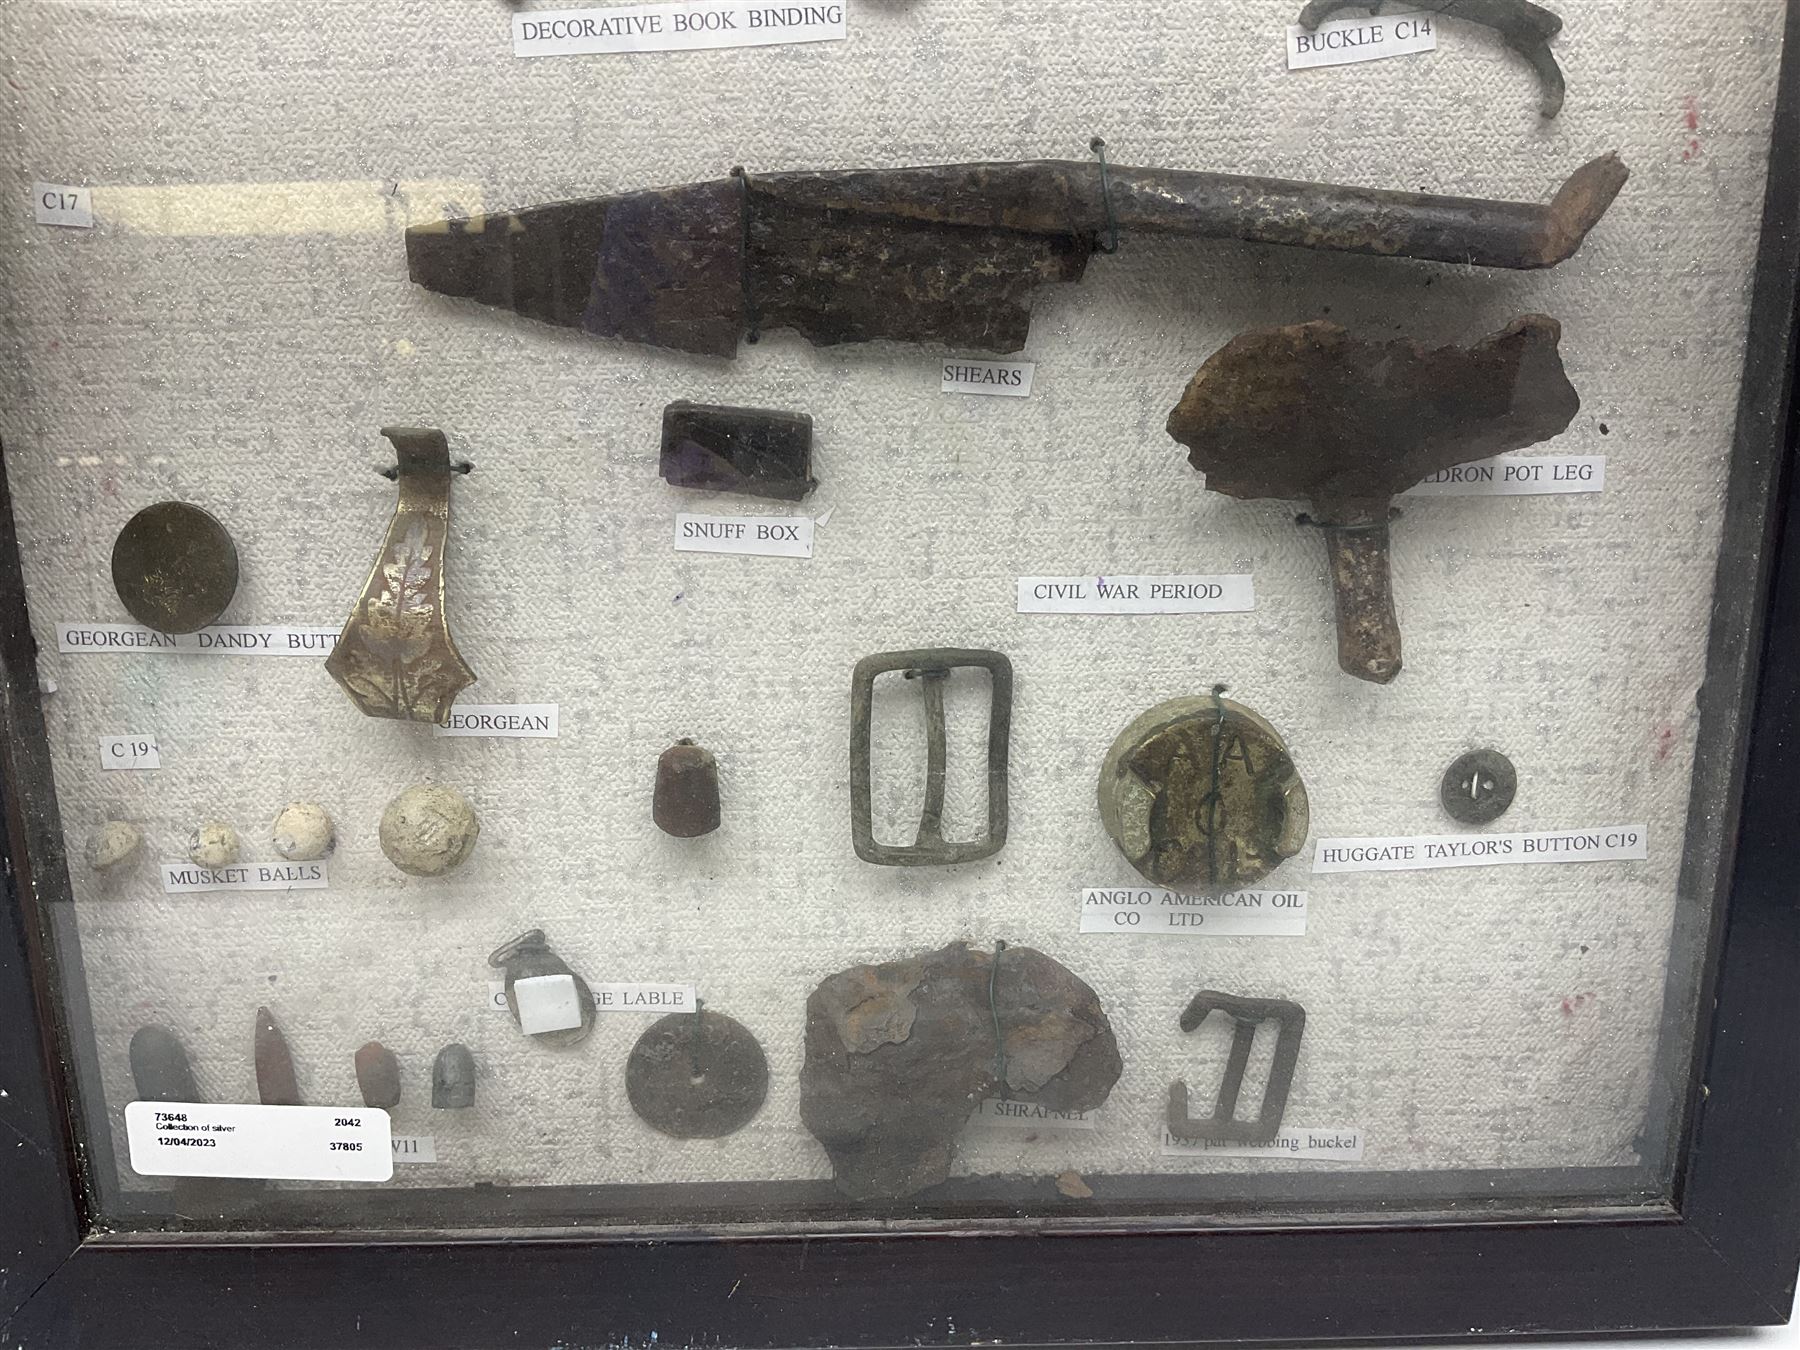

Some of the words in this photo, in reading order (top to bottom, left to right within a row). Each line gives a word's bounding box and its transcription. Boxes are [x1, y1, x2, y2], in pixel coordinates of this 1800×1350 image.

[522, 15, 663, 41] DECORATIVE
[674, 11, 738, 32] BOOK
[747, 5, 843, 29] BINDING
[1296, 25, 1384, 54] BUCKLE
[1395, 18, 1432, 40] C14
[42, 192, 78, 210] C17
[943, 365, 1022, 386] SHEARS
[1503, 465, 1543, 482] POT
[1553, 464, 1594, 481] LEG
[683, 522, 746, 539] SNUFF
[757, 524, 800, 541] BOX
[1033, 584, 1087, 599] CIVIL
[1096, 584, 1140, 599] WAR
[1150, 583, 1223, 599] PERIOD
[66, 630, 177, 648] GEORGEAN
[199, 633, 272, 648] DANDY
[1322, 845, 1415, 863] HUGGATE
[1424, 839, 1512, 858] TAYLOR'S
[1522, 835, 1600, 853] BUTTON
[1605, 833, 1638, 848] C19
[169, 868, 249, 885] MUSKET
[258, 865, 322, 882] BALLS
[1086, 891, 1152, 906] ANGLO
[1271, 893, 1304, 909] OIL
[1114, 911, 1141, 926] CO
[1168, 912, 1204, 927] LTD
[623, 991, 684, 1006] LABLE
[154, 1112, 188, 1122] 73648
[334, 1118, 361, 1127] 2042
[155, 1122, 199, 1132] Collection
[201, 1124, 210, 1132] of
[212, 1124, 236, 1132] silver
[157, 1137, 216, 1148] 12/04/2023
[329, 1142, 363, 1152] 37805
[1308, 1135, 1357, 1149] buckel
